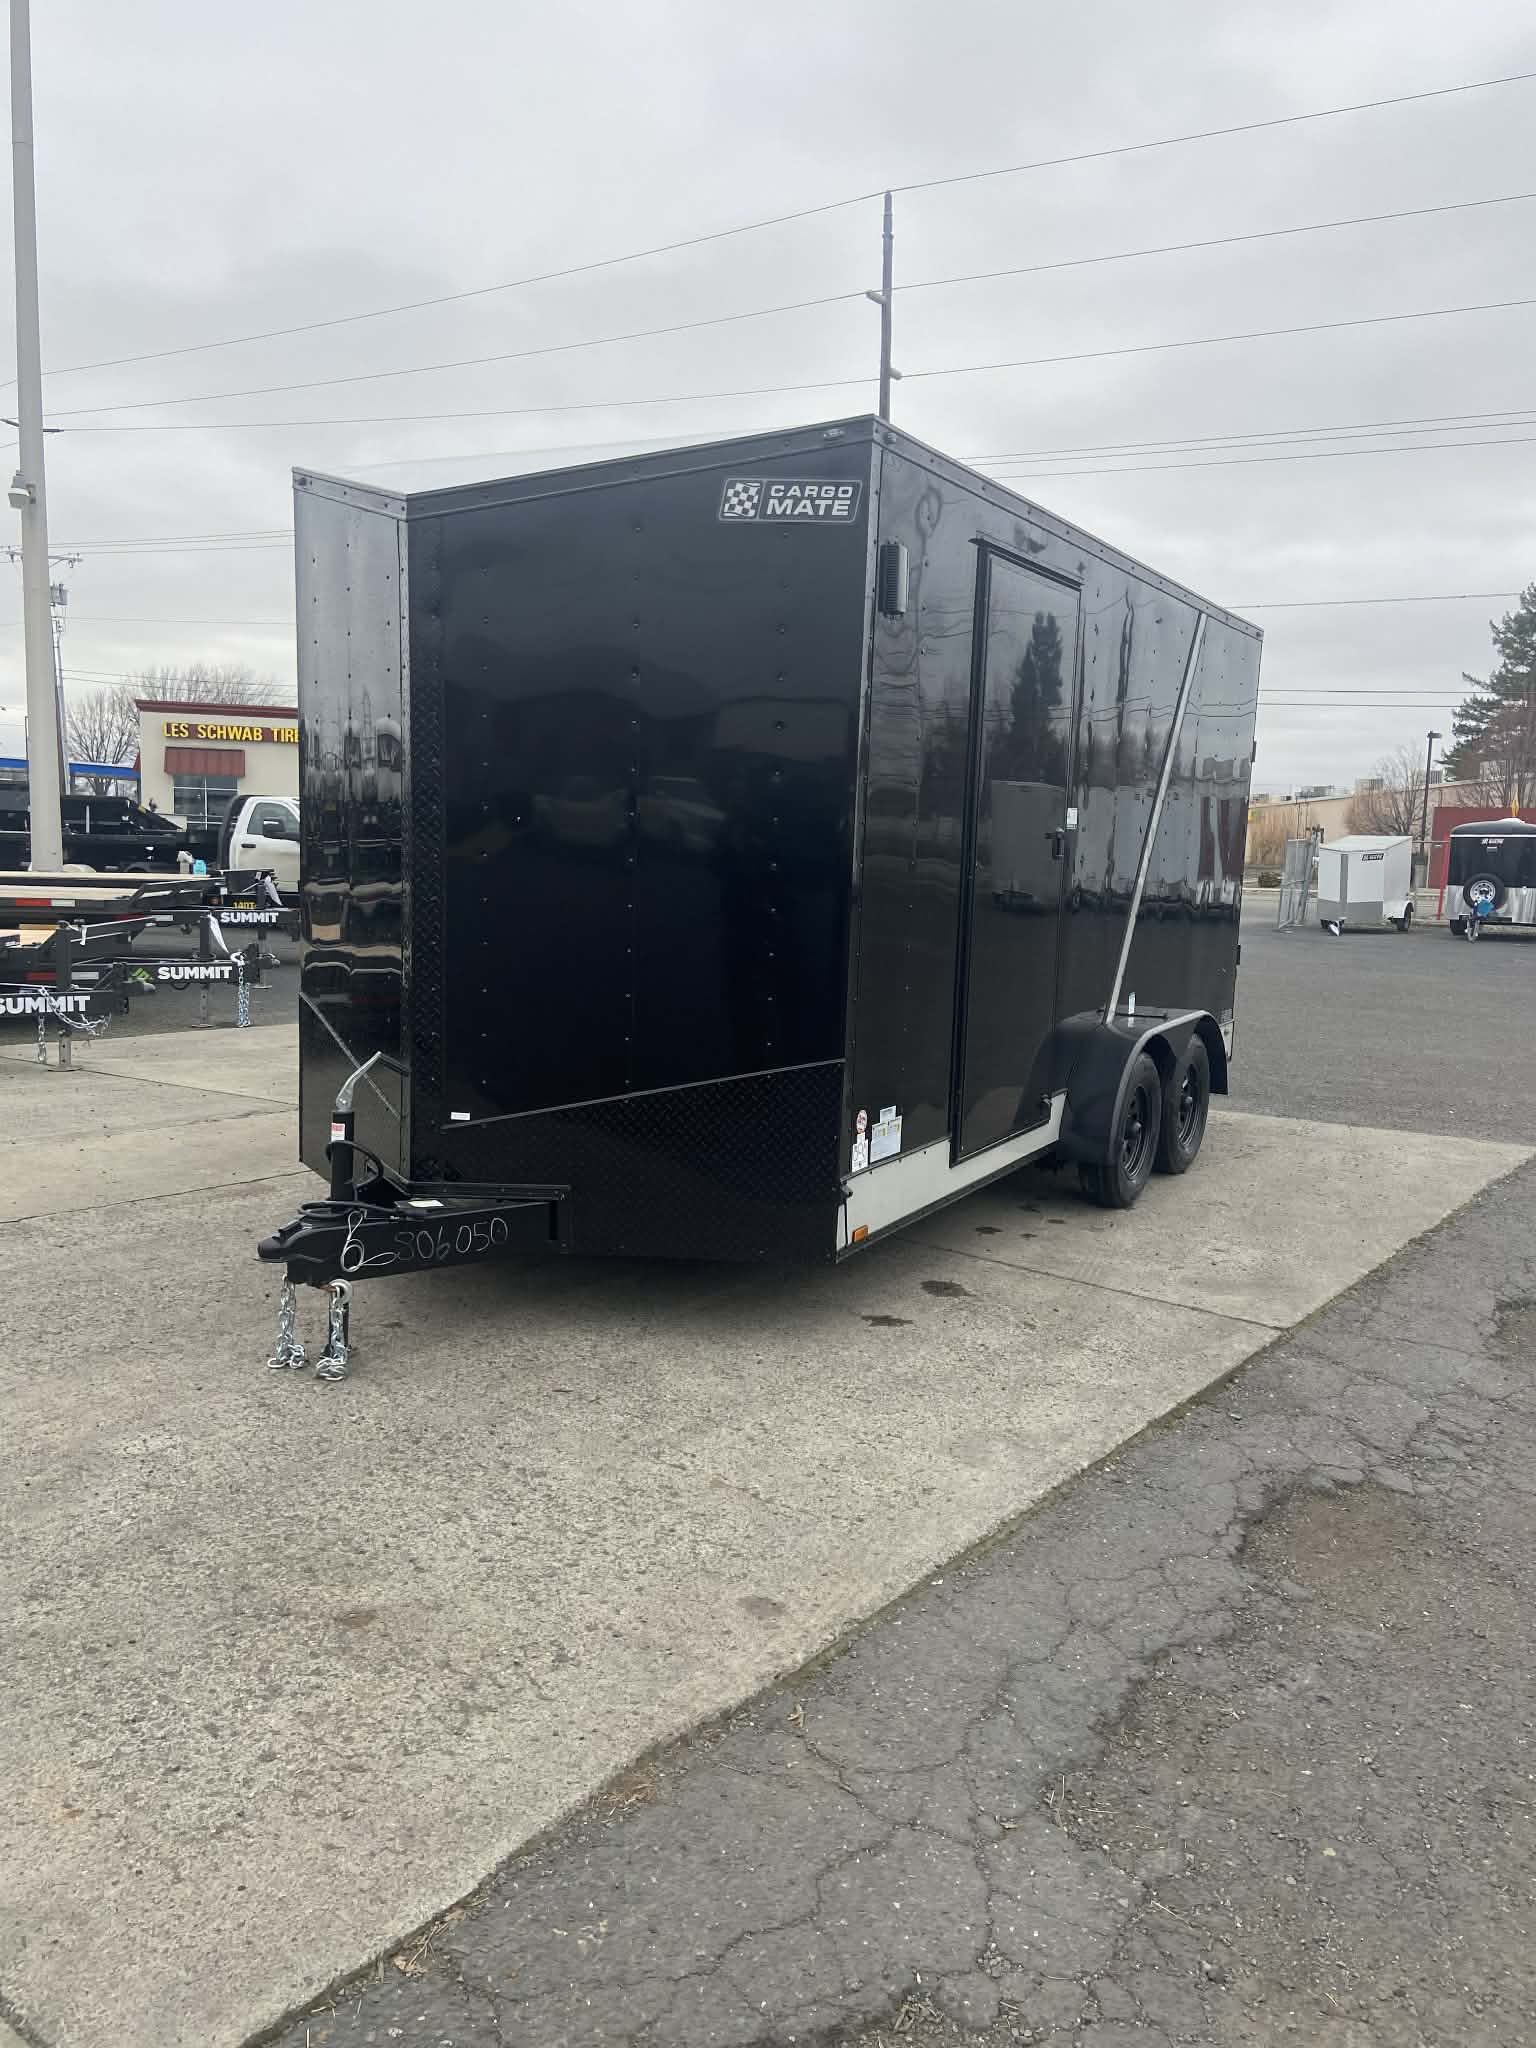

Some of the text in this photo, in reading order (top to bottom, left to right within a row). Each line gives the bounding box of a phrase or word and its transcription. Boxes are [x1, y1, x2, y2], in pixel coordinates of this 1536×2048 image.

[770, 484, 853, 498] CARGO
[766, 498, 850, 516] MATE
[164, 722, 189, 738] LES
[198, 724, 263, 741] SCHWAB
[220, 911, 279, 923] SUMMIT
[158, 965, 233, 980] SUMMIT
